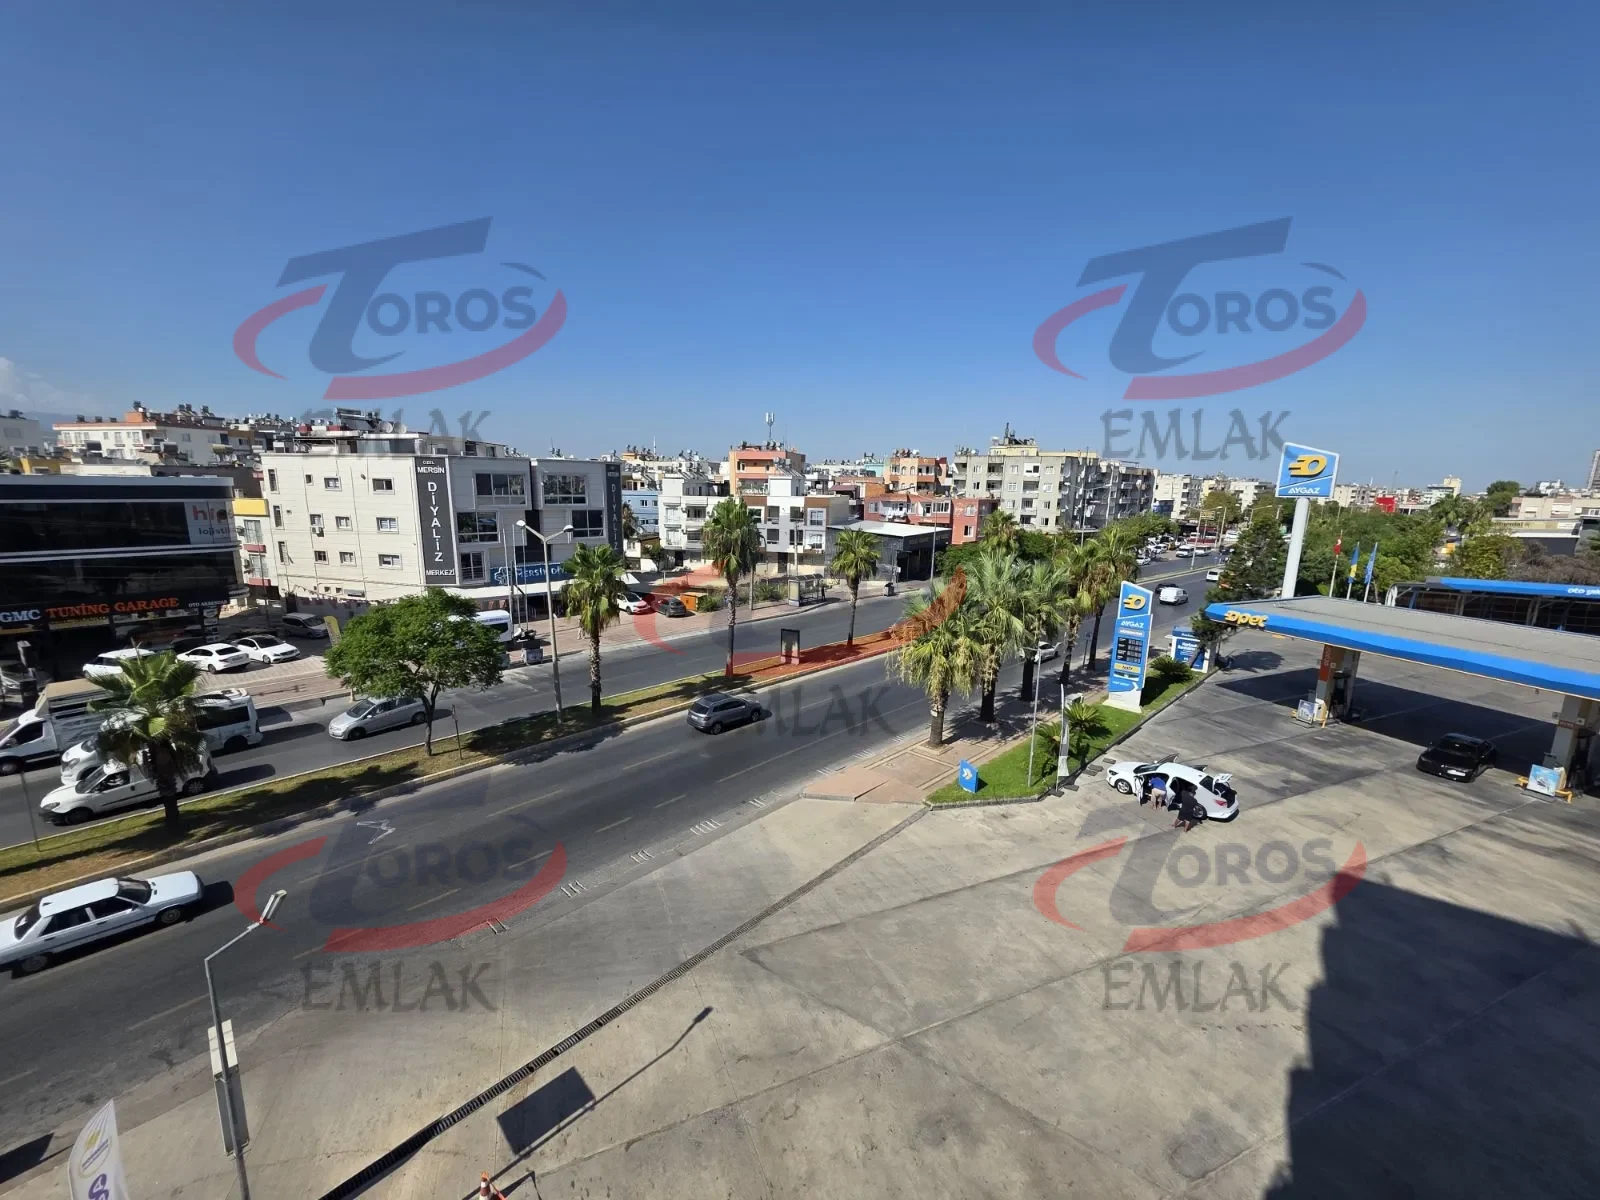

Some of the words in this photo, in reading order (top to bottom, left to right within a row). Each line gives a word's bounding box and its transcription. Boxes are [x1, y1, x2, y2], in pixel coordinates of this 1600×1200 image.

[427, 482, 444, 562] DİYALİZ
[426, 568, 455, 576] MERKEZİ
[114, 598, 179, 612] GARAGE
[0, 609, 40, 622] GMC
[1120, 620, 1145, 629] AYGAZ
